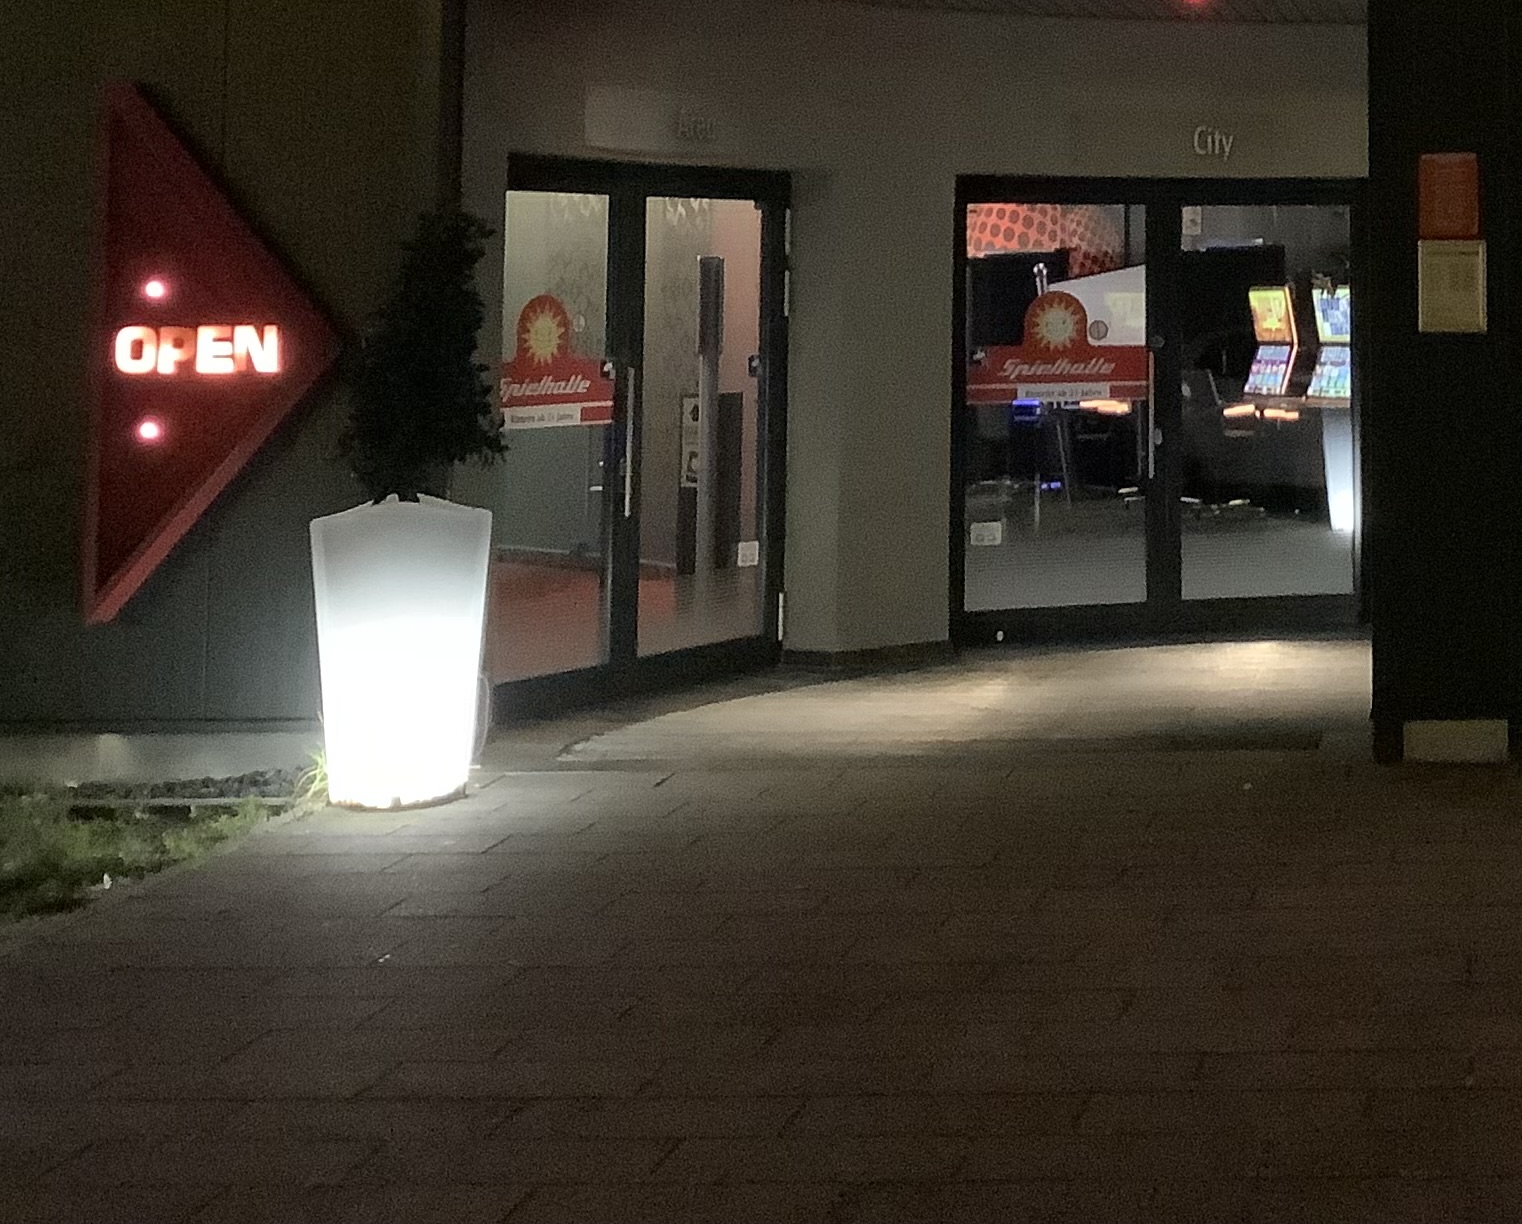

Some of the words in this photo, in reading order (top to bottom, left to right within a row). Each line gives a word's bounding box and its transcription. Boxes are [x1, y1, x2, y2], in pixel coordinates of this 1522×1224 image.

[1193, 125, 1234, 163] City
[114, 324, 280, 375] OPEN
[999, 357, 1117, 380] Spielhalle
